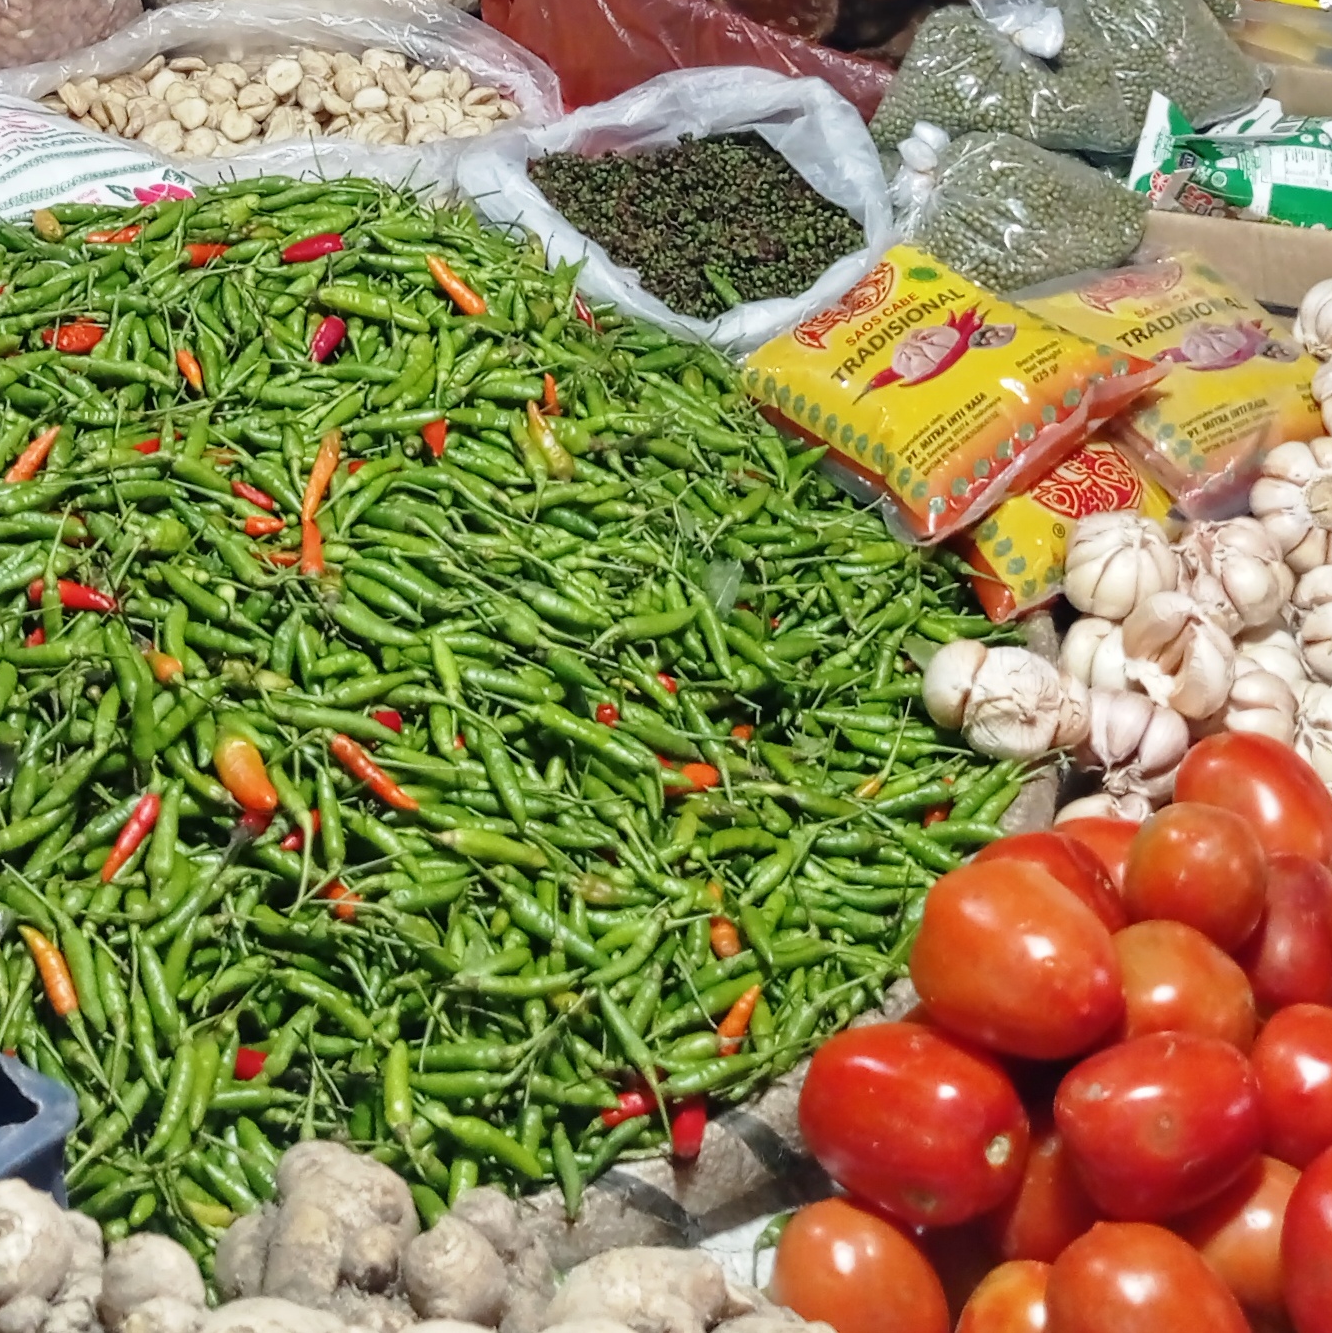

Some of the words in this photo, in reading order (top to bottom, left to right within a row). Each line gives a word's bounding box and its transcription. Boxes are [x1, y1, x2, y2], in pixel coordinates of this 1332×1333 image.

[830, 287, 967, 383] TRADISIONAL
[845, 317, 883, 348] SAOS
[881, 291, 921, 318] CABE
[1032, 369, 1049, 385] 625
[919, 424, 947, 451] MITRA
[946, 407, 966, 428] INTI
